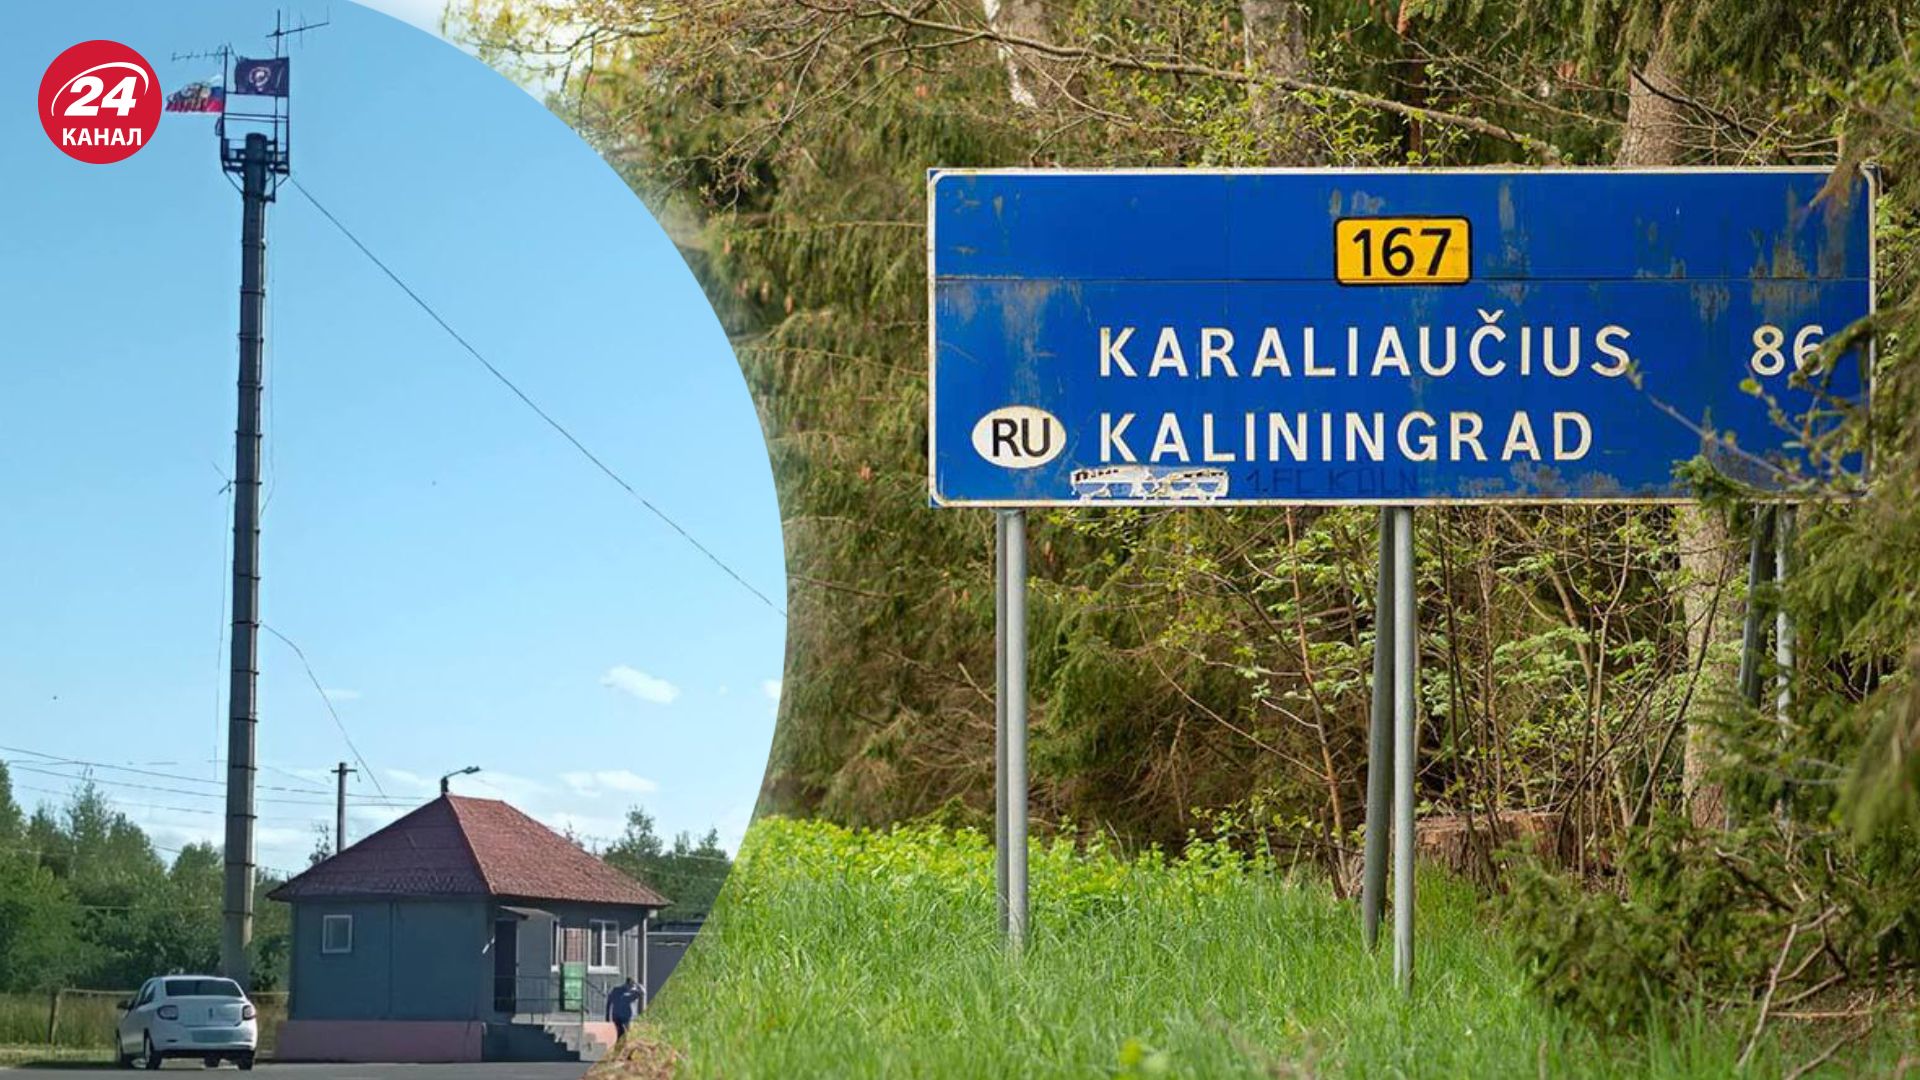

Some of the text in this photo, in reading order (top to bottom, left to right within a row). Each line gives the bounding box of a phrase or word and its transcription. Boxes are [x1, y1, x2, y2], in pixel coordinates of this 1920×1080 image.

[1353, 227, 1453, 276] 167
[1100, 309, 1829, 378] KARALIAUČIUS 86
[991, 418, 1052, 457] RU
[1100, 411, 1593, 463] KALININGRAD
